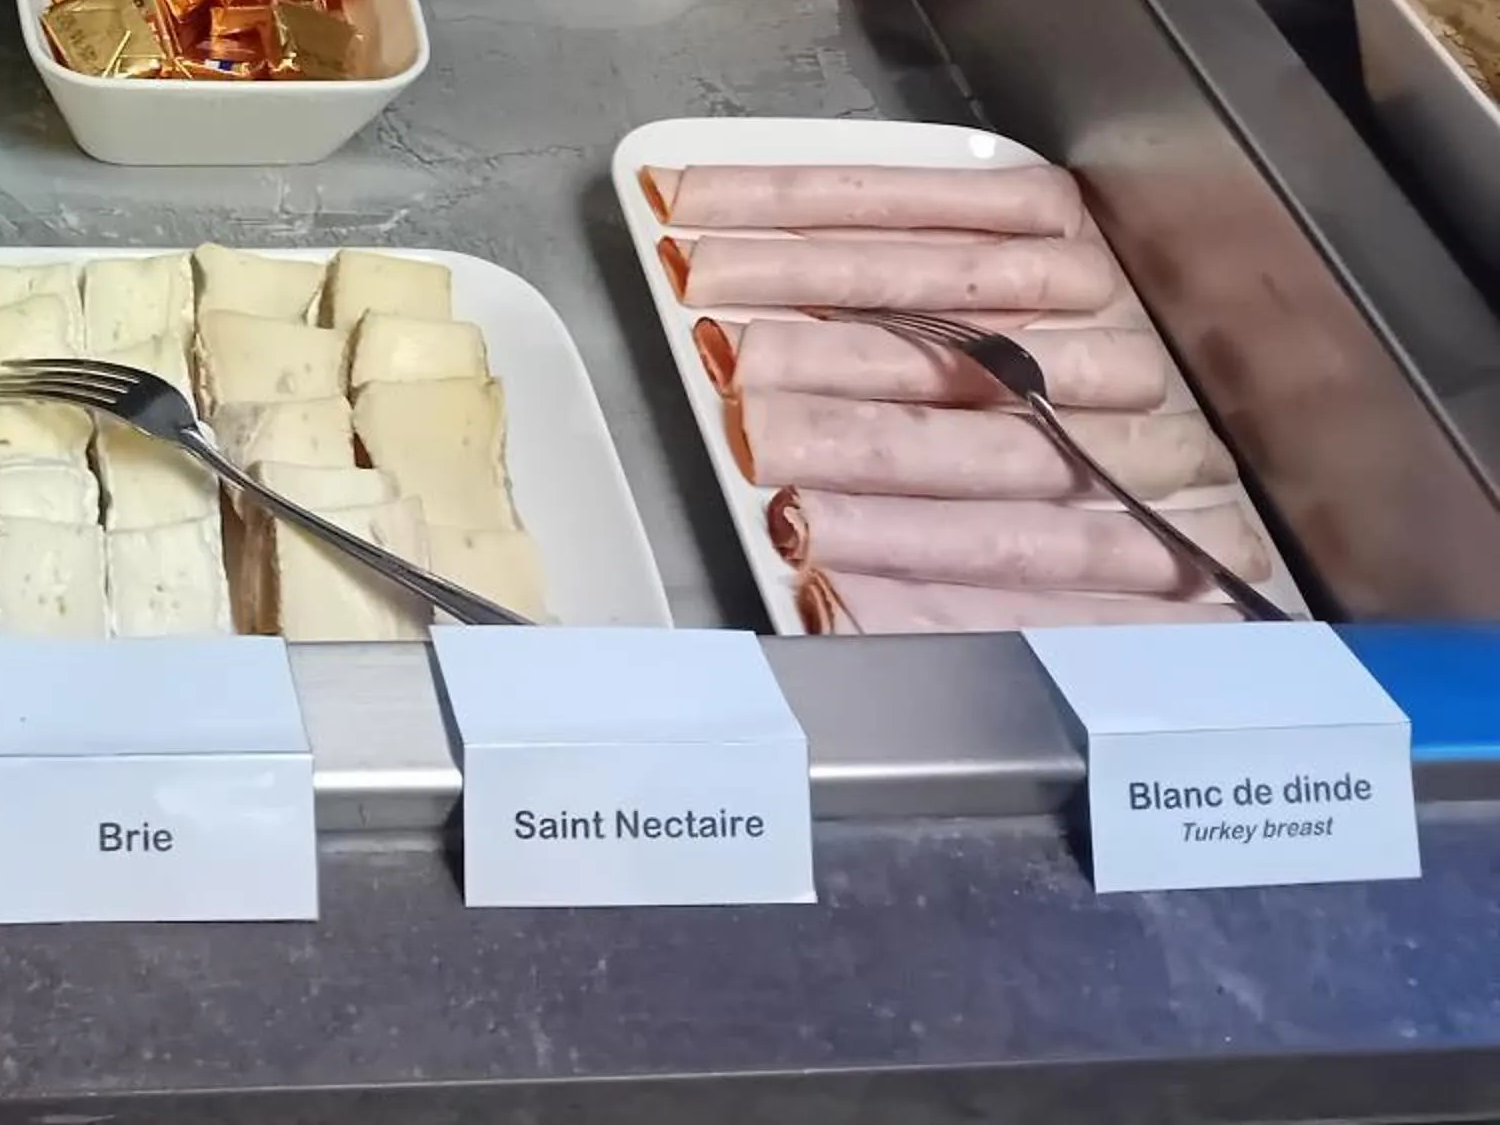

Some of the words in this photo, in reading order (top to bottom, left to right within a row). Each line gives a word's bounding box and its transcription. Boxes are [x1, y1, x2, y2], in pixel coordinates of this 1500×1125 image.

[1128, 781, 1223, 811] Blanc
[1232, 777, 1273, 807] de
[1282, 772, 1372, 805] dinde
[99, 821, 173, 852] Brie
[514, 810, 605, 840] Saint
[615, 808, 765, 839] Nectaire
[1183, 820, 1259, 844] Turkey
[1263, 816, 1334, 839] breast
